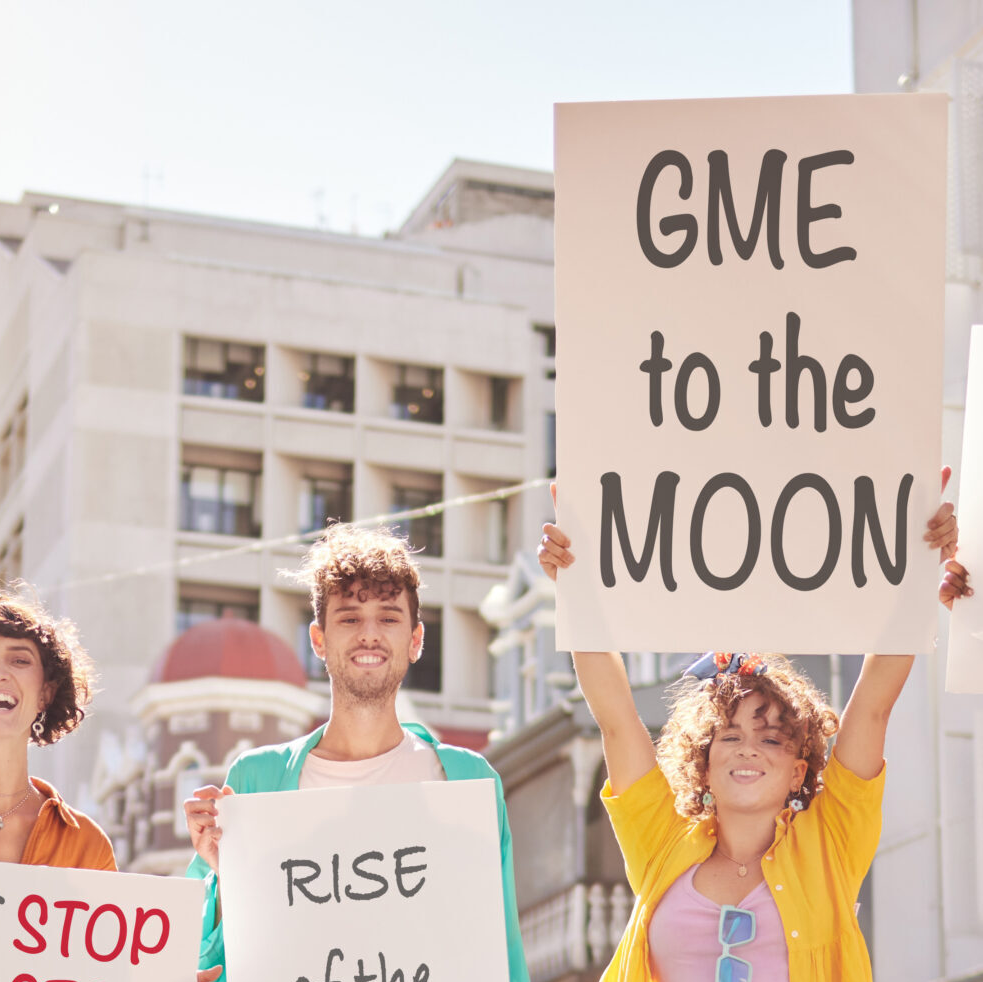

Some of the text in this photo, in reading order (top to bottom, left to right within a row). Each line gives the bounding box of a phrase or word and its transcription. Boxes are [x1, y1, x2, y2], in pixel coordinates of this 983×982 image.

[636, 148, 858, 271] GME
[639, 311, 876, 433] to the
[599, 470, 914, 593] MOON
[12, 894, 171, 966] STOP
[280, 845, 428, 907] RISE
